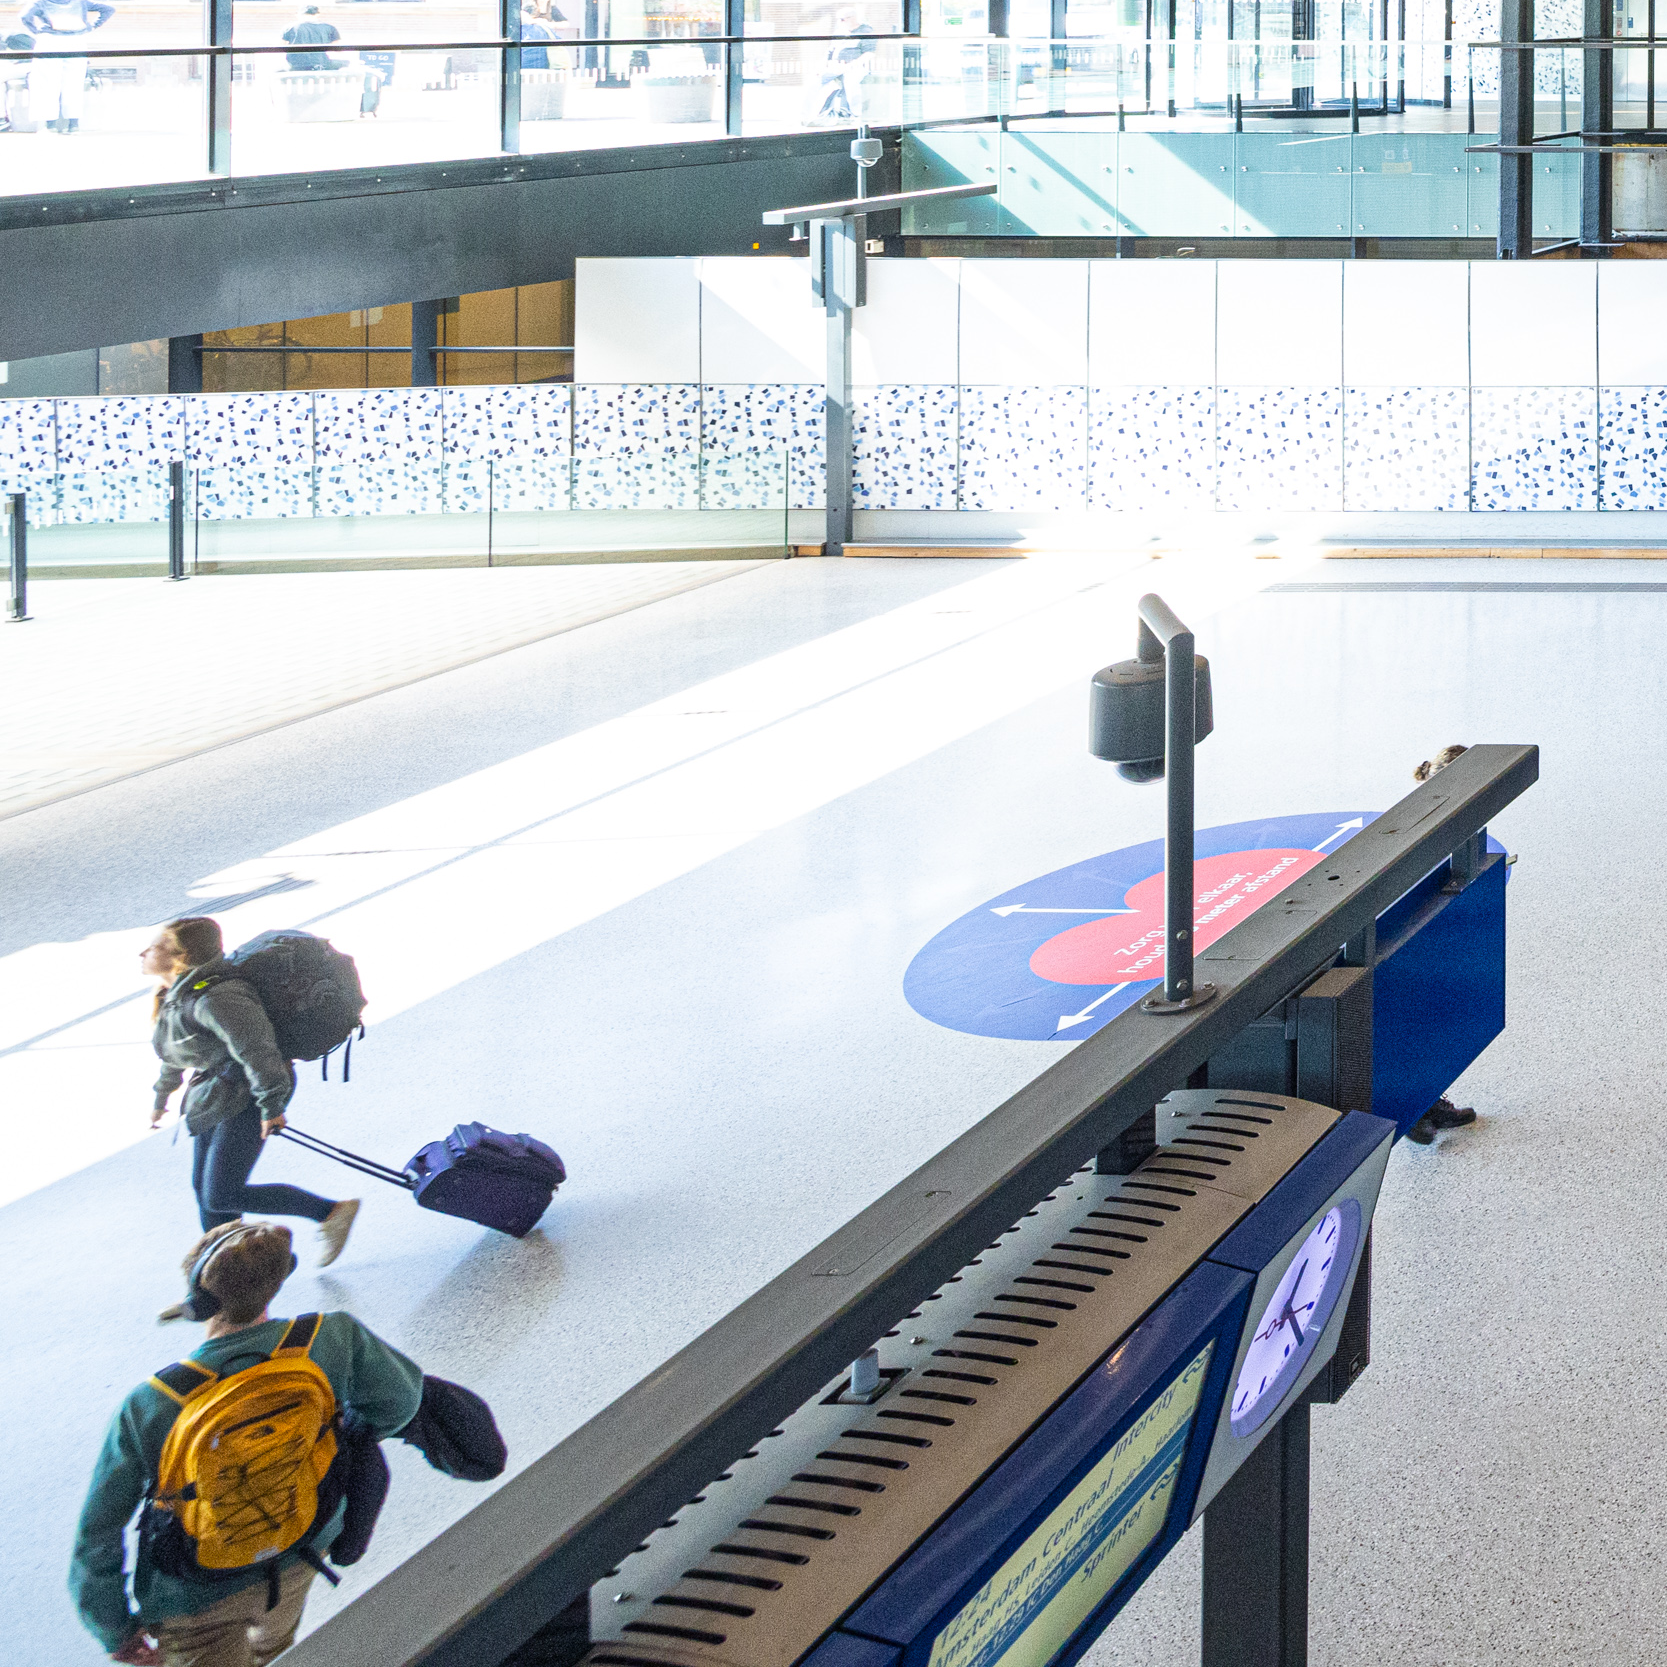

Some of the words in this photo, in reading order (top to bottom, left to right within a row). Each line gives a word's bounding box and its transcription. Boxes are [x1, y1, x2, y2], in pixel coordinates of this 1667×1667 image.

[1194, 894, 1246, 924] meter
[1241, 857, 1299, 893] afstand
[1197, 872, 1253, 904] elkaar,
[1113, 930, 1165, 955] Zorg
[941, 1579, 993, 1649] 12:24
[1113, 1382, 1179, 1463] Intercity
[1081, 1500, 1146, 1584] Sprinter
[935, 1556, 1038, 1667] Amsterdam
[1043, 1466, 1115, 1558] Centraal
